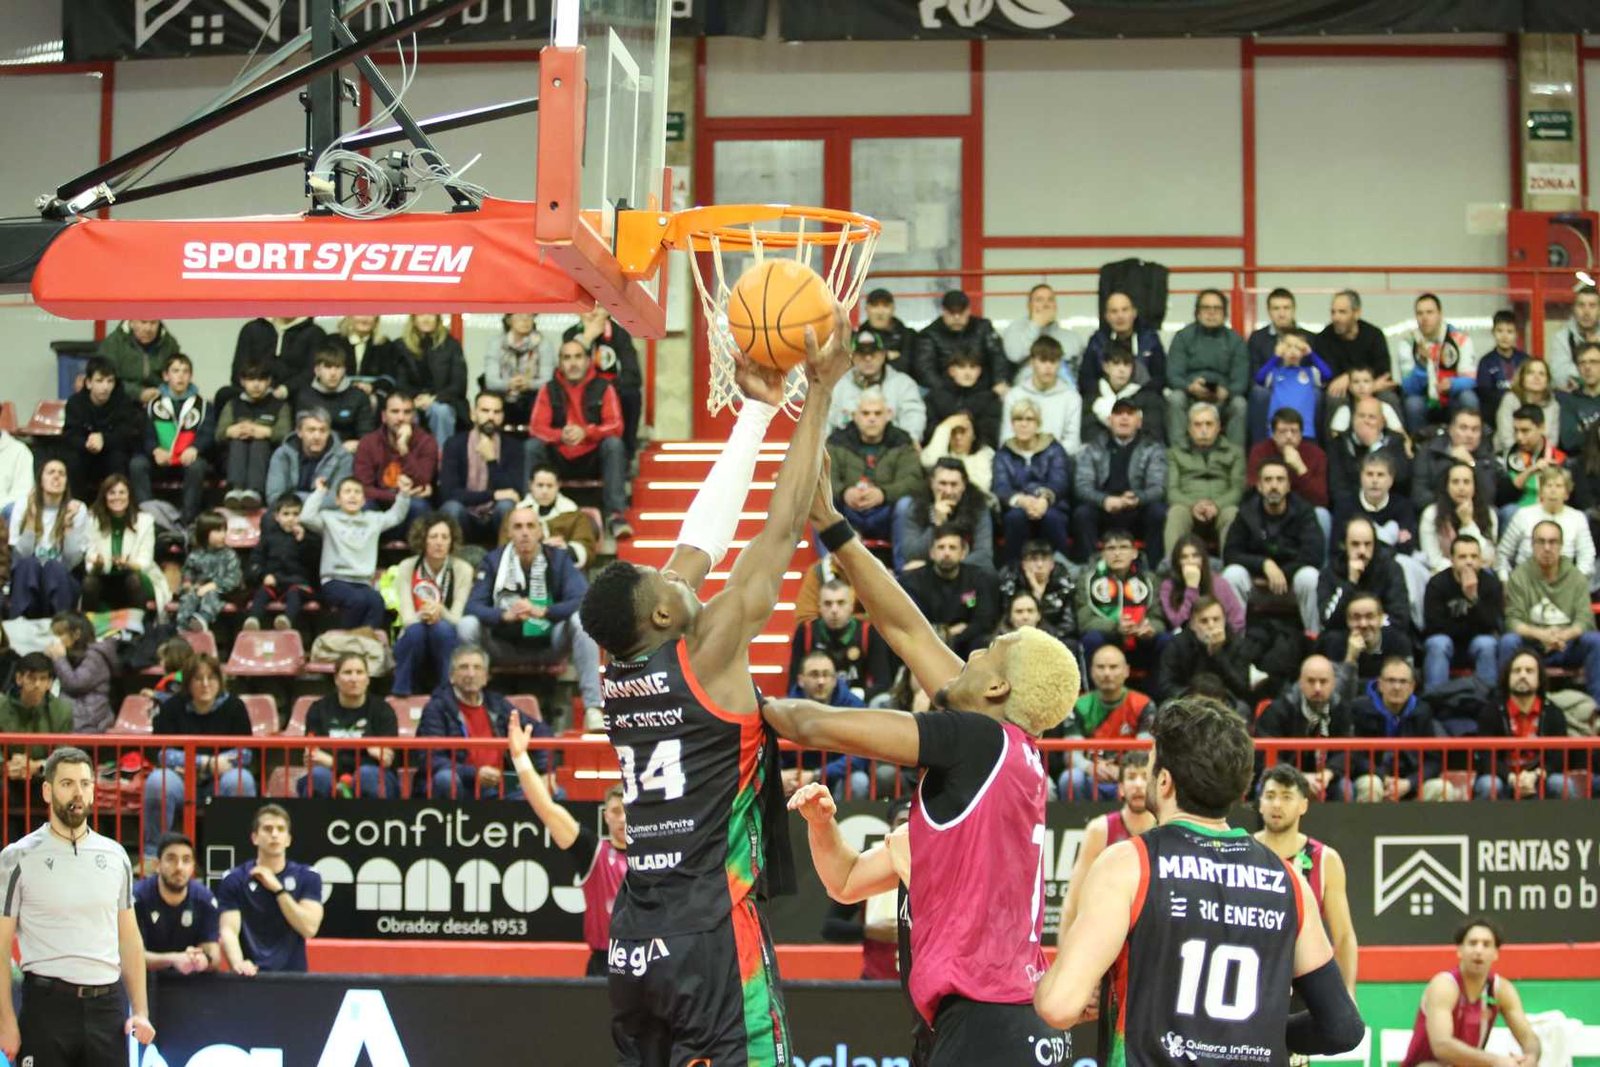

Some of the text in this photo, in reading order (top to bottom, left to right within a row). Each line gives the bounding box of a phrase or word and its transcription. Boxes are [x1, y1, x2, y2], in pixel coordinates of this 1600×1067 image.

[183, 242, 473, 275] SPORT SYSTEM
[1478, 838, 1593, 872] RENTAS Y
[1158, 855, 1287, 894] MARTINEZ
[1479, 876, 1598, 911] Inmob
[377, 916, 528, 936] Obrador desde 1953
[1199, 899, 1286, 931] RIC ENERGY
[1176, 938, 1260, 1021] 10
[1186, 1039, 1272, 1056] Quimera Infinita
